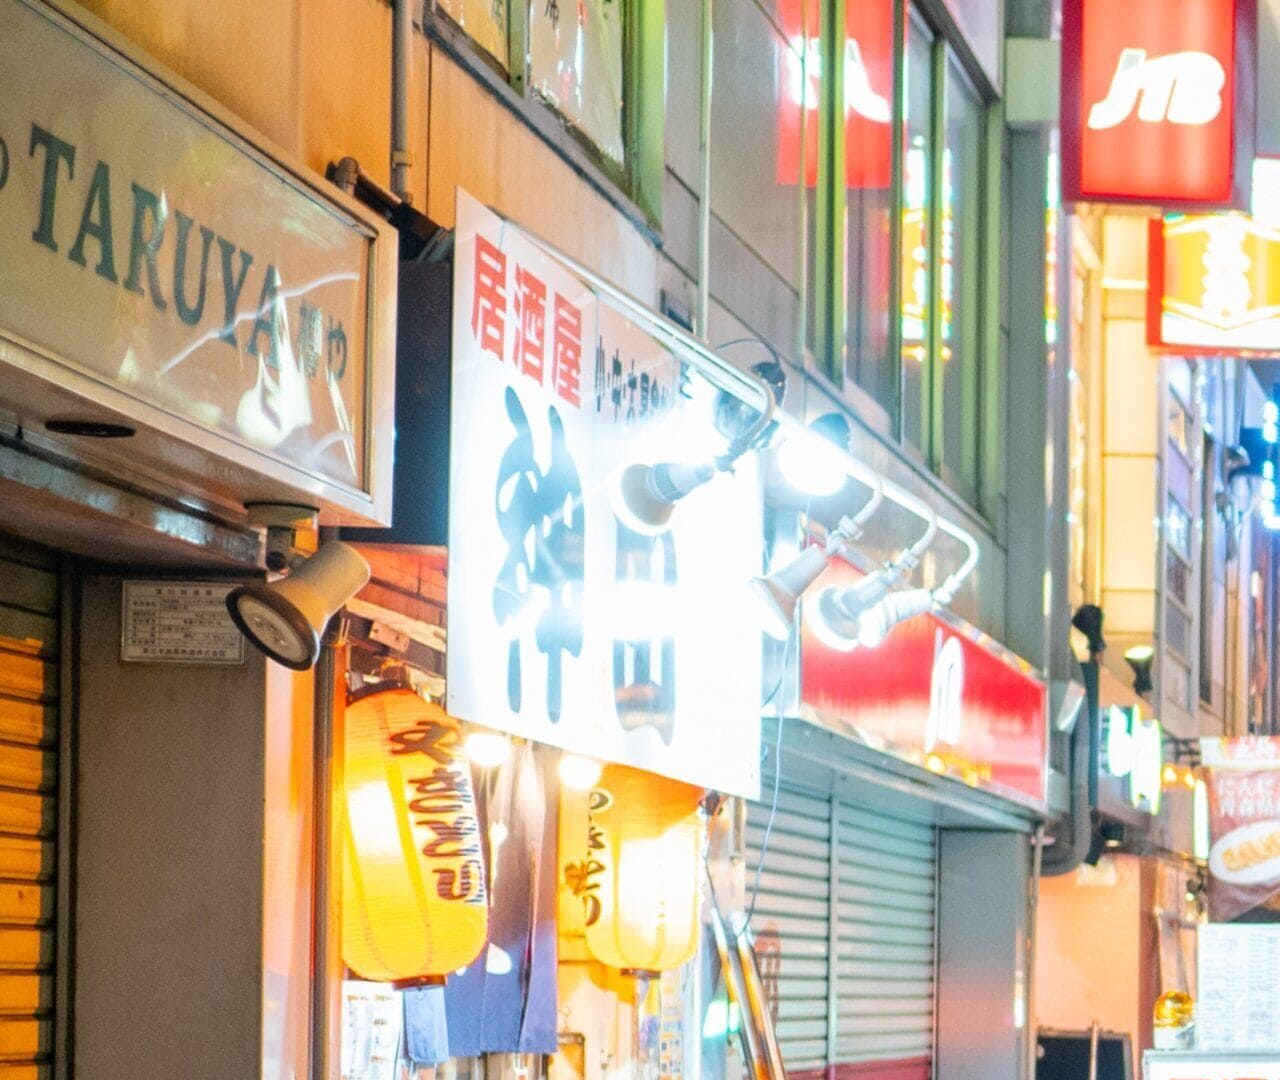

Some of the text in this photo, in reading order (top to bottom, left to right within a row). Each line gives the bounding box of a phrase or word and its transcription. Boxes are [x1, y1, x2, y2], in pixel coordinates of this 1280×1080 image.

[1088, 48, 1226, 129] JTB
[28, 121, 283, 372] TARUYA
[471, 232, 582, 409] 居酒屋
